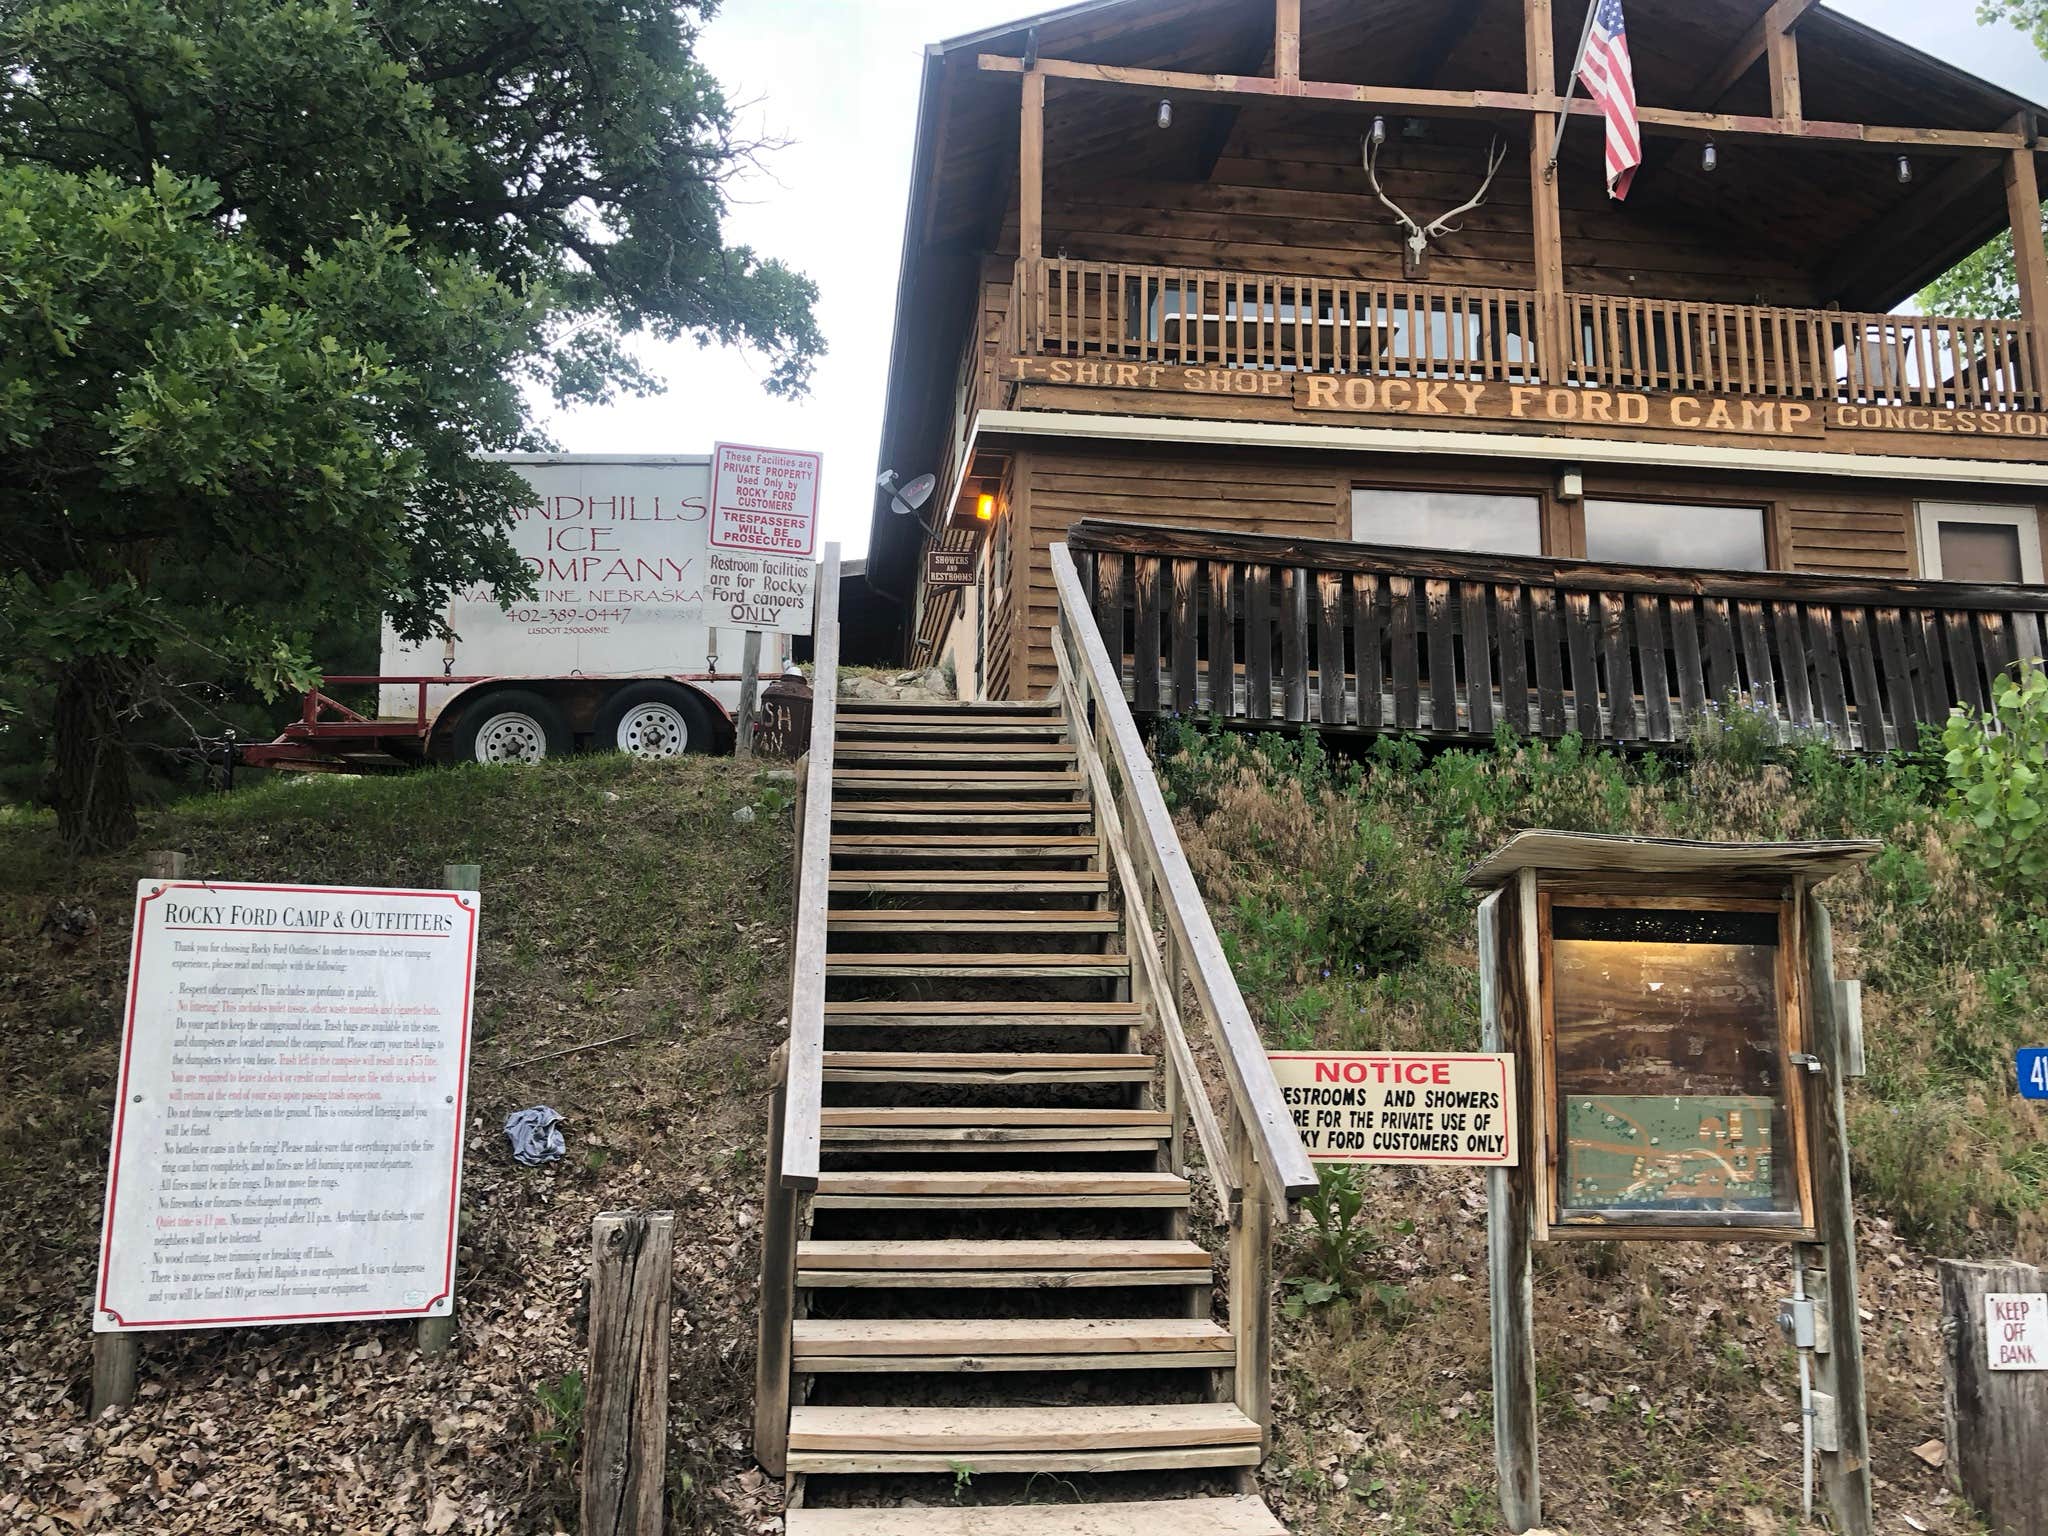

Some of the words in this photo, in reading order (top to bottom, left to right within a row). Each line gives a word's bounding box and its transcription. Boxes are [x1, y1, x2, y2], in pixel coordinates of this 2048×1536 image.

[1010, 358, 1166, 388] T-SHIRT
[1184, 369, 1284, 395] SHOP
[1306, 375, 1486, 416] ROCKY
[1509, 386, 1650, 425] FORD
[1670, 396, 1812, 434] CAMP
[726, 451, 751, 462] These
[757, 454, 796, 467] Facilities
[799, 460, 812, 469] are
[724, 463, 760, 475] PRIVATE
[766, 467, 813, 480] PROPERTY
[737, 474, 758, 486] Used
[764, 477, 783, 489] Only
[788, 480, 798, 491] by
[736, 487, 767, 498] ROCKY
[773, 489, 796, 501] FORD
[738, 497, 793, 511] CUSTOMERS
[724, 512, 806, 528] TRESPASSERS
[547, 527, 620, 551] ICE
[724, 532, 802, 549] PROSECUTED
[739, 525, 766, 535] WILL
[774, 527, 789, 537] BE
[521, 557, 692, 582] OMPANY
[711, 555, 758, 573] Restroom
[763, 560, 808, 578] facilities
[935, 556, 969, 565] SHOWERS
[710, 575, 729, 586] are
[737, 574, 755, 589] for
[764, 576, 807, 596] Rocky
[931, 572, 973, 581] RESTROOMS
[590, 590, 703, 602] NEBRASKA
[712, 587, 744, 603] Ford
[754, 592, 804, 609] canoers
[506, 609, 631, 624] 402-389-0447
[731, 605, 780, 622] ONLY
[527, 626, 561, 635] USDOT
[164, 903, 226, 925] ROCKY
[231, 905, 278, 926] FORD
[282, 907, 331, 928] CAMP
[333, 910, 346, 928] &
[350, 909, 454, 932] OUTFITTERS
[1315, 1062, 1451, 1084] NOTICE
[1280, 1087, 1367, 1106] ESTROOMS
[1384, 1090, 1415, 1108] AND
[1425, 1091, 1499, 1109] SHOWERS
[1289, 1110, 1309, 1127] RE
[1317, 1110, 1341, 1127] FOR
[1350, 1111, 1374, 1128] THE
[1381, 1112, 1434, 1130] PRIVATE
[1442, 1114, 1464, 1131] USE
[1474, 1114, 1491, 1131] OF
[1328, 1132, 1365, 1149] FORD
[1373, 1133, 1458, 1152] CUSTOMERS
[1467, 1135, 1505, 1153] ONLY
[1996, 1301, 2029, 1321] KEEP
[2004, 1323, 2027, 1342] OFF
[2000, 1345, 2037, 1364] BANK
